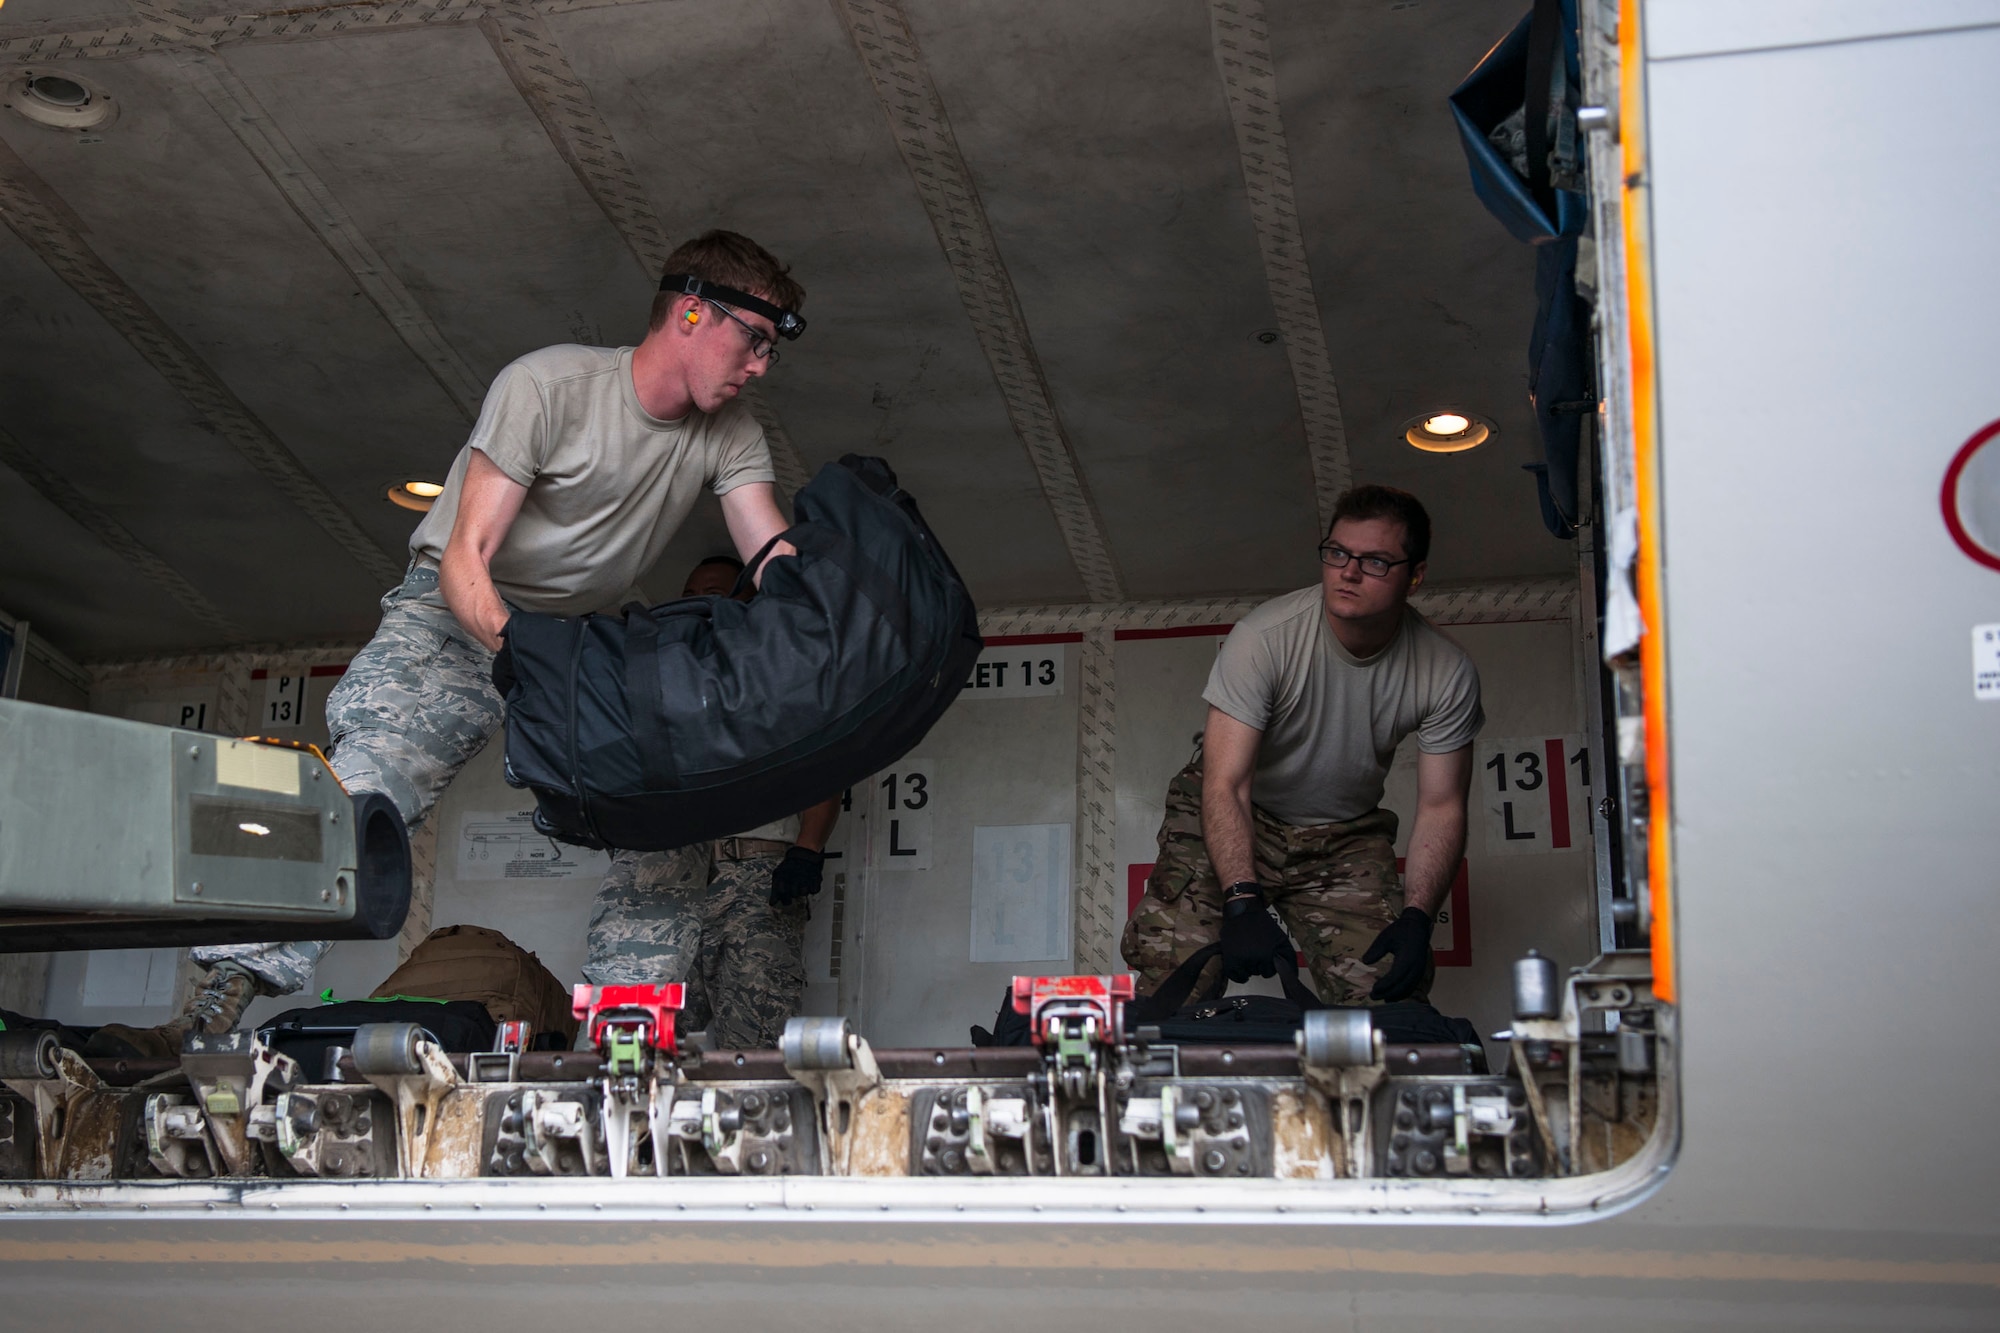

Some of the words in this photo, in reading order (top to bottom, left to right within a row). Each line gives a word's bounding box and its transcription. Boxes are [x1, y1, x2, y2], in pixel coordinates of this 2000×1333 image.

[279, 676, 290, 693] P
[1021, 659, 1055, 686] 13
[181, 706, 194, 726] P
[270, 701, 291, 721] 13
[1486, 751, 1543, 791] 13
[881, 773, 929, 810] 13
[1503, 801, 1535, 840] L
[889, 819, 917, 856] L
